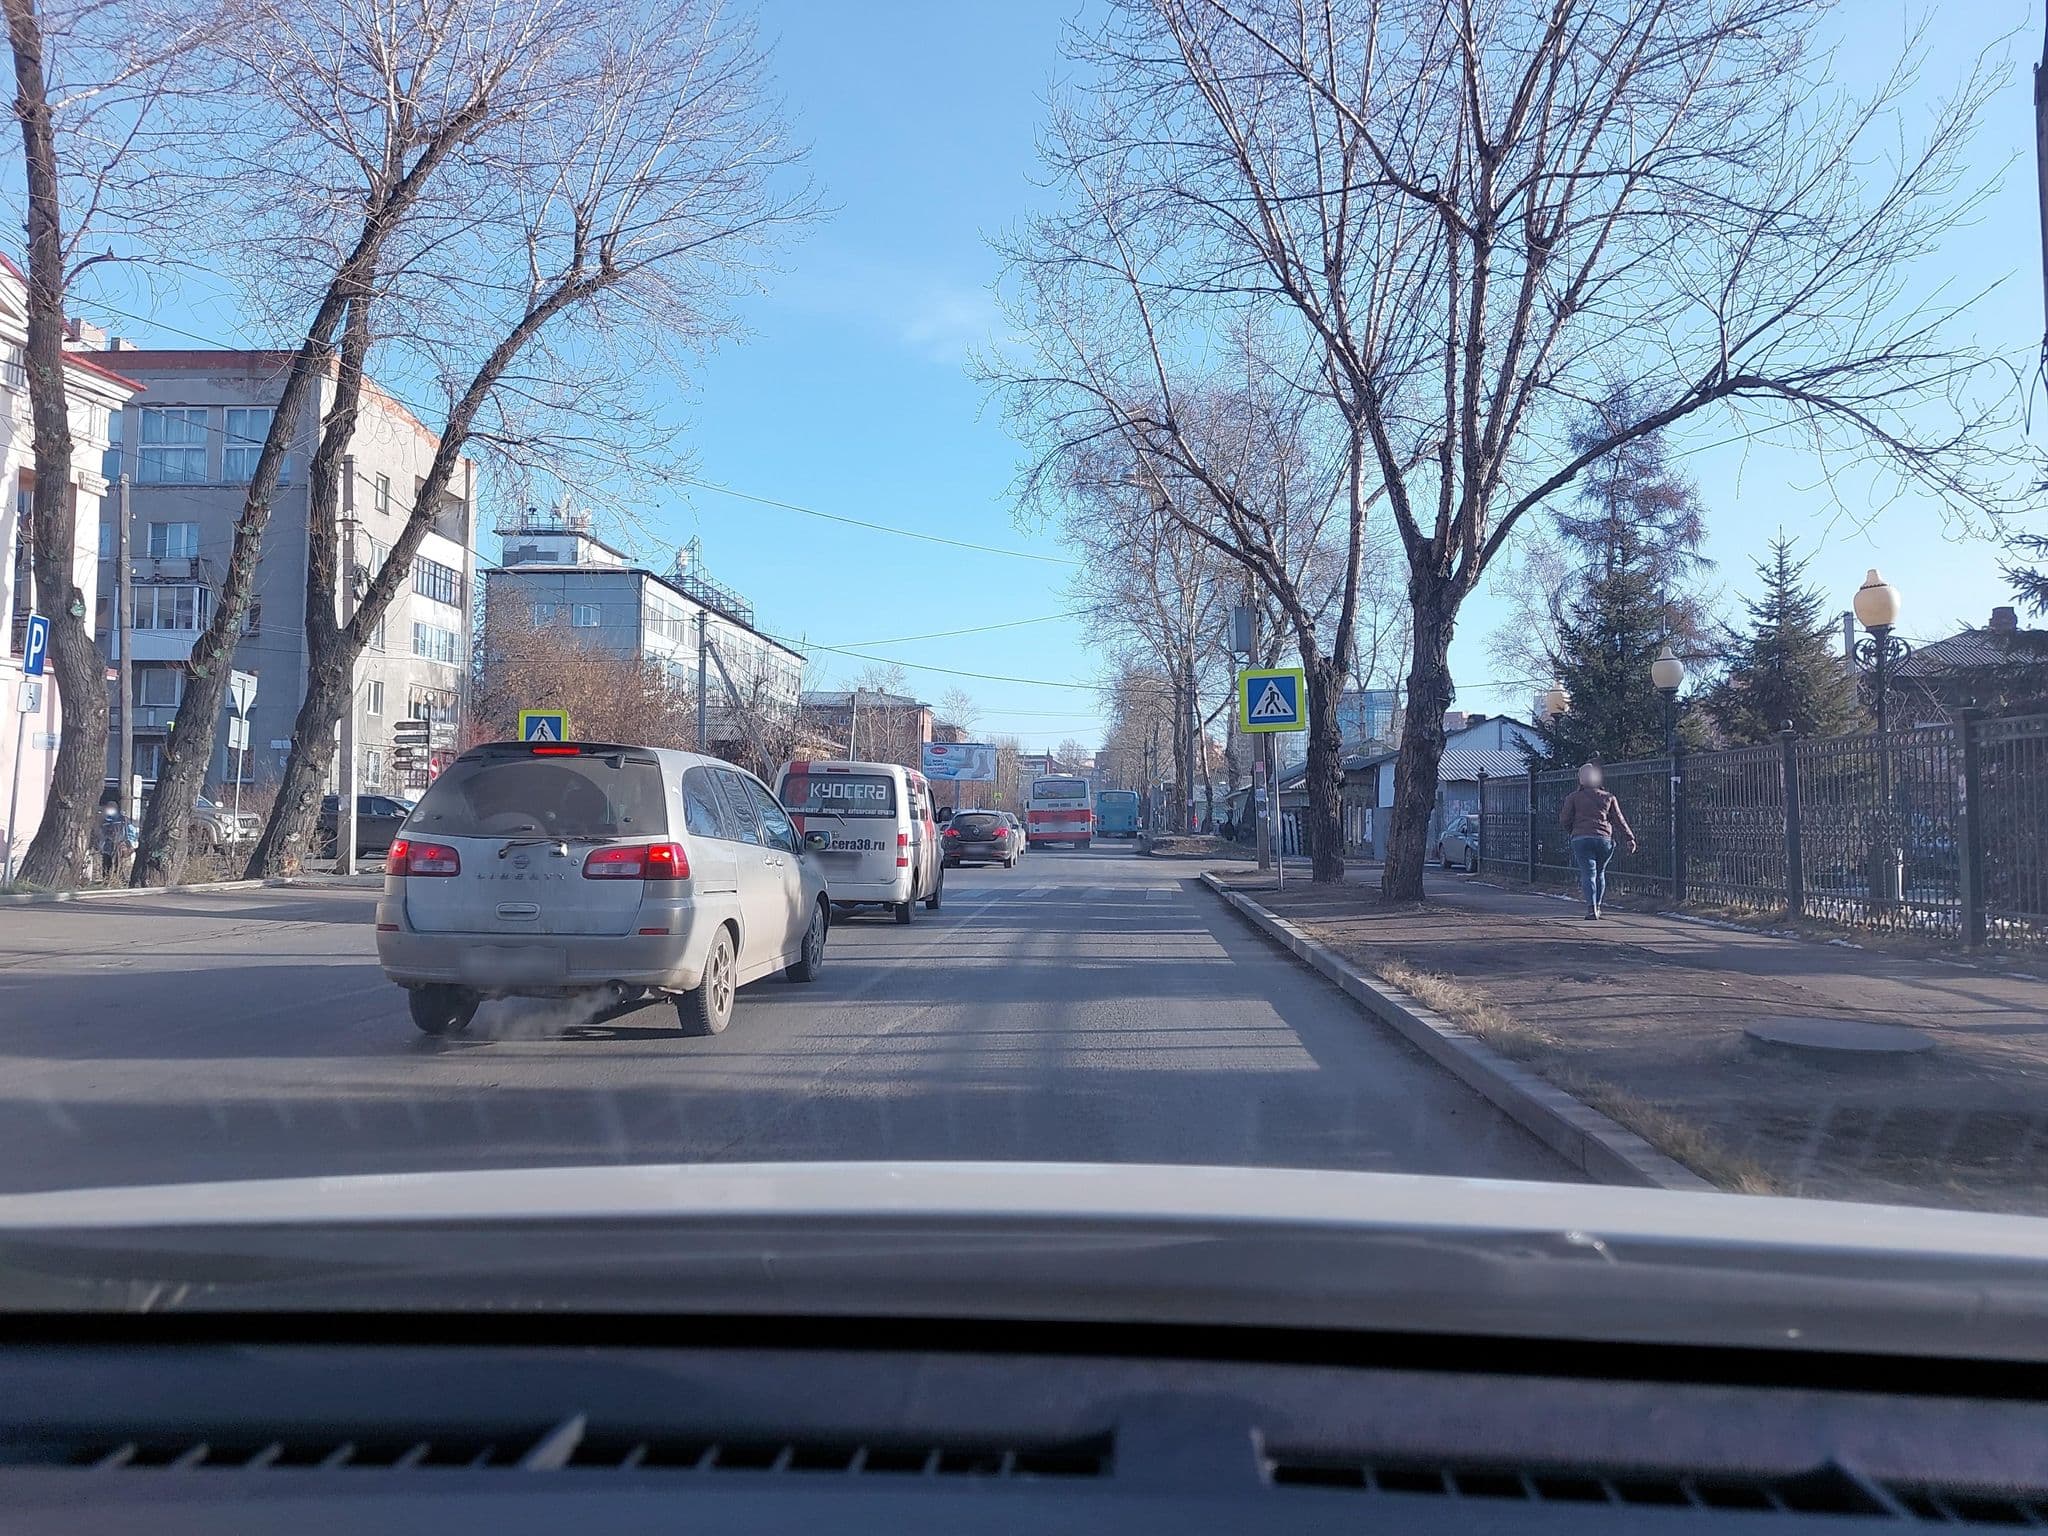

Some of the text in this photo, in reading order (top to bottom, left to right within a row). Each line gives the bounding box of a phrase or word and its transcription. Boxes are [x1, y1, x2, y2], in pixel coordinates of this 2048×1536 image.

[28, 622, 45, 668] P
[810, 783, 886, 800] KYOCERA
[829, 838, 886, 851] cera38.ru
